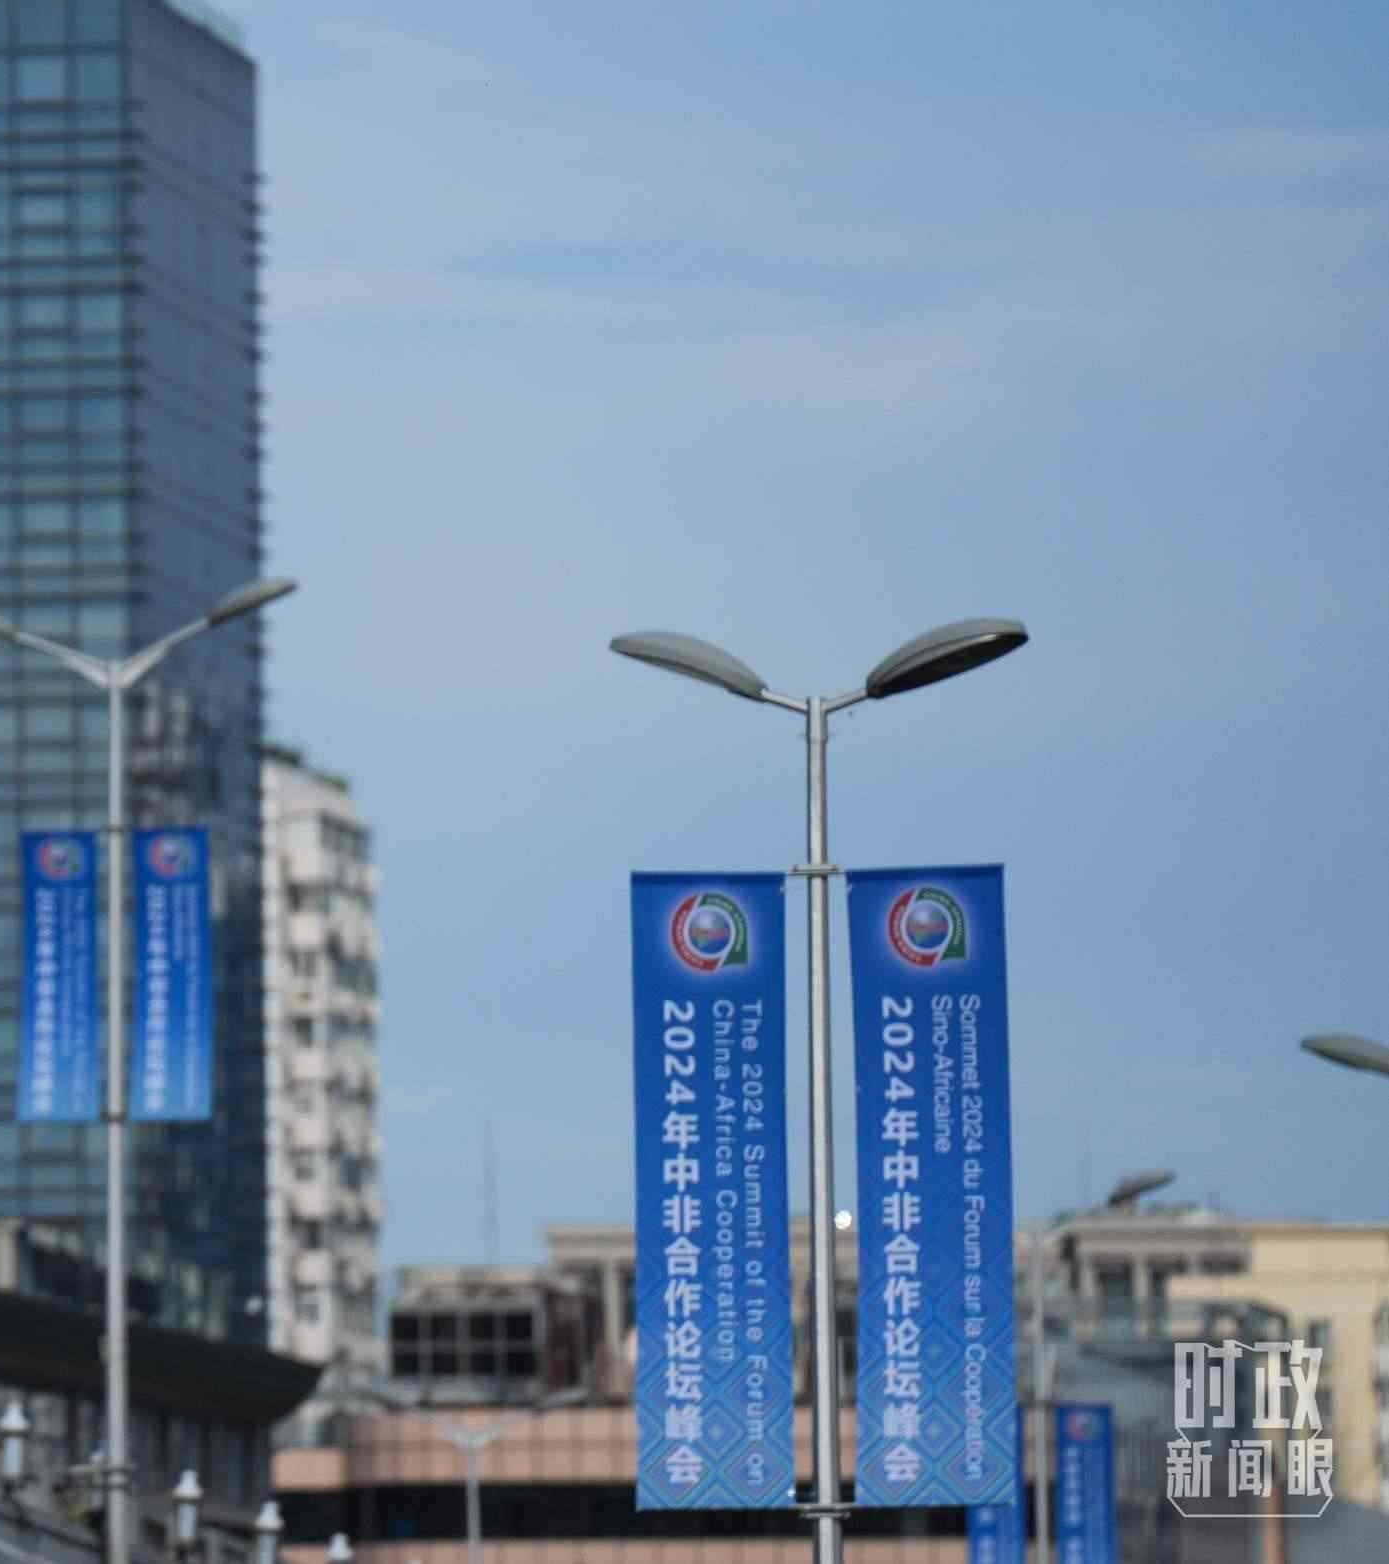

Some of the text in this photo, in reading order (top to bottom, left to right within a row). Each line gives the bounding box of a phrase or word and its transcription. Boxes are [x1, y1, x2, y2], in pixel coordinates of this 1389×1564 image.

[931, 995, 955, 1153] Sino-Africaine
[959, 994, 981, 1090] Sommet
[961, 1094, 983, 1153] 2024
[712, 1000, 738, 1362] China-Africa Cooperation
[962, 1156, 985, 1188] du
[740, 1000, 768, 1485] The 2024 Summit of the Forum on
[963, 1195, 986, 1270] Forum
[963, 1318, 985, 1338] la
[964, 1275, 981, 1315] sur
